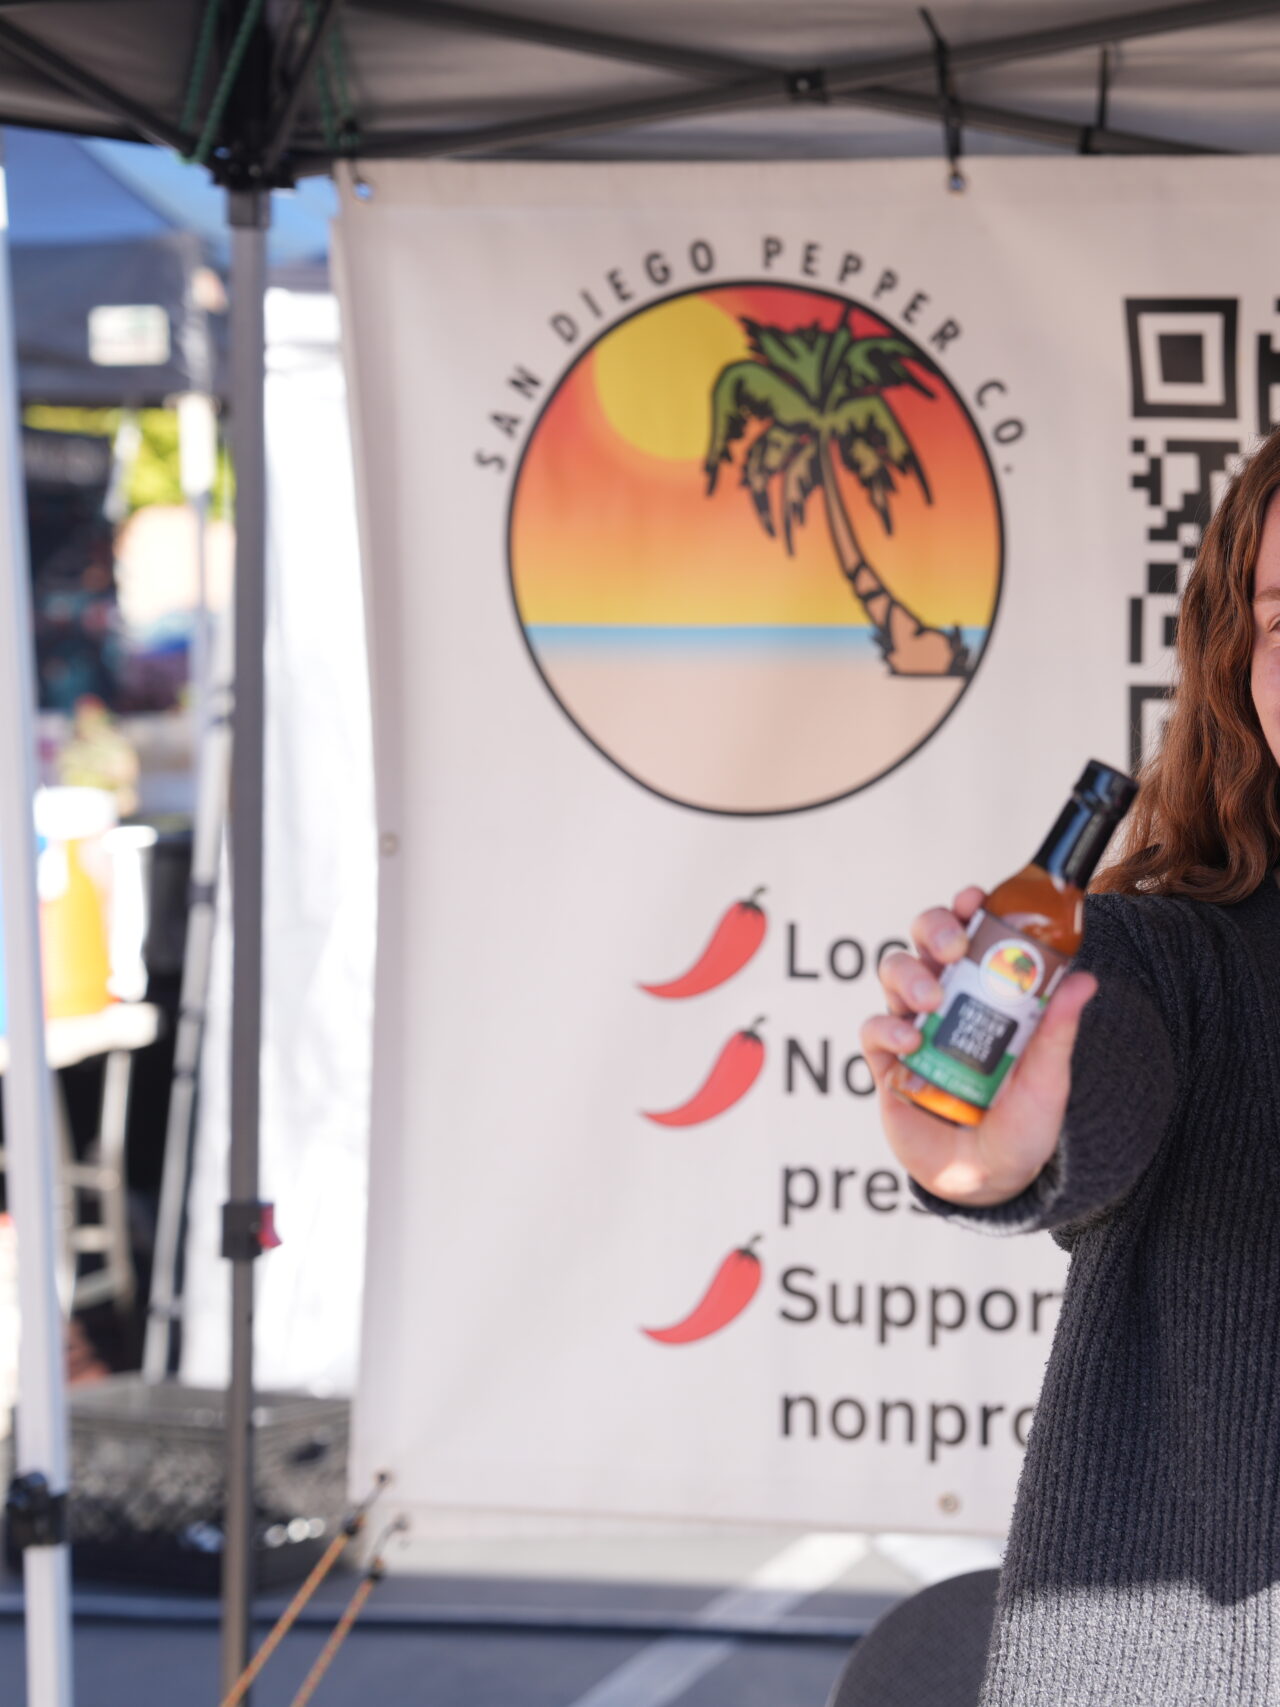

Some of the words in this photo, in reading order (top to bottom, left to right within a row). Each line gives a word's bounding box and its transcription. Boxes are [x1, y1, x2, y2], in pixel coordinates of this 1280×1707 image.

[475, 366, 541, 473] SAN
[549, 240, 716, 347] DIEGO
[762, 237, 962, 353] PEPPER
[781, 1165, 935, 1227] pre
[778, 1266, 1064, 1347] Suppor
